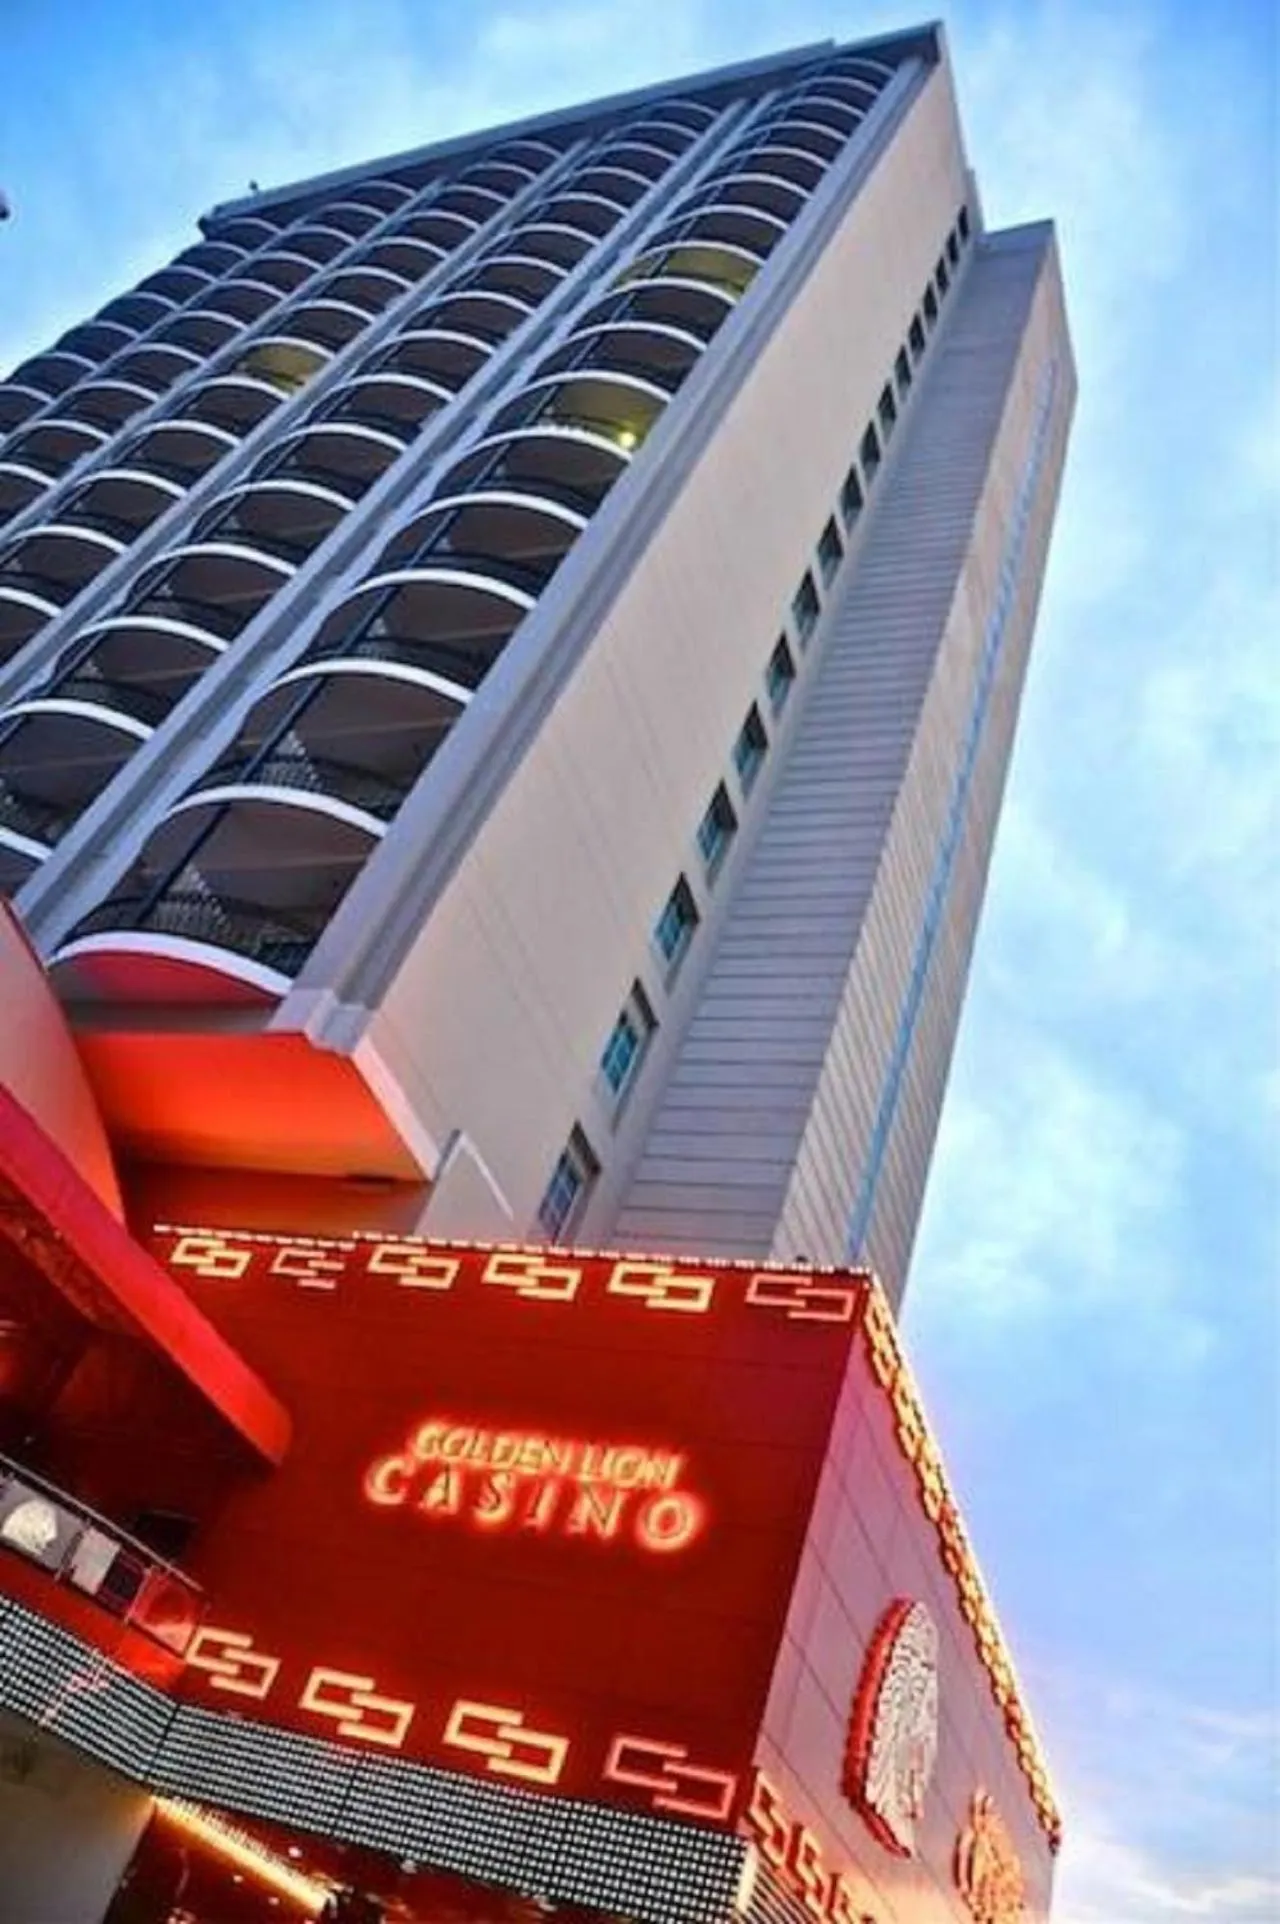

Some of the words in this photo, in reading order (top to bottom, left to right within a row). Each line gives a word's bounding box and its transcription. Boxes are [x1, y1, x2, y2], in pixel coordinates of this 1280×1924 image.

[413, 1421, 572, 1476] GOLDEN
[579, 1443, 684, 1489] LION
[364, 1453, 704, 1552] CASINO
